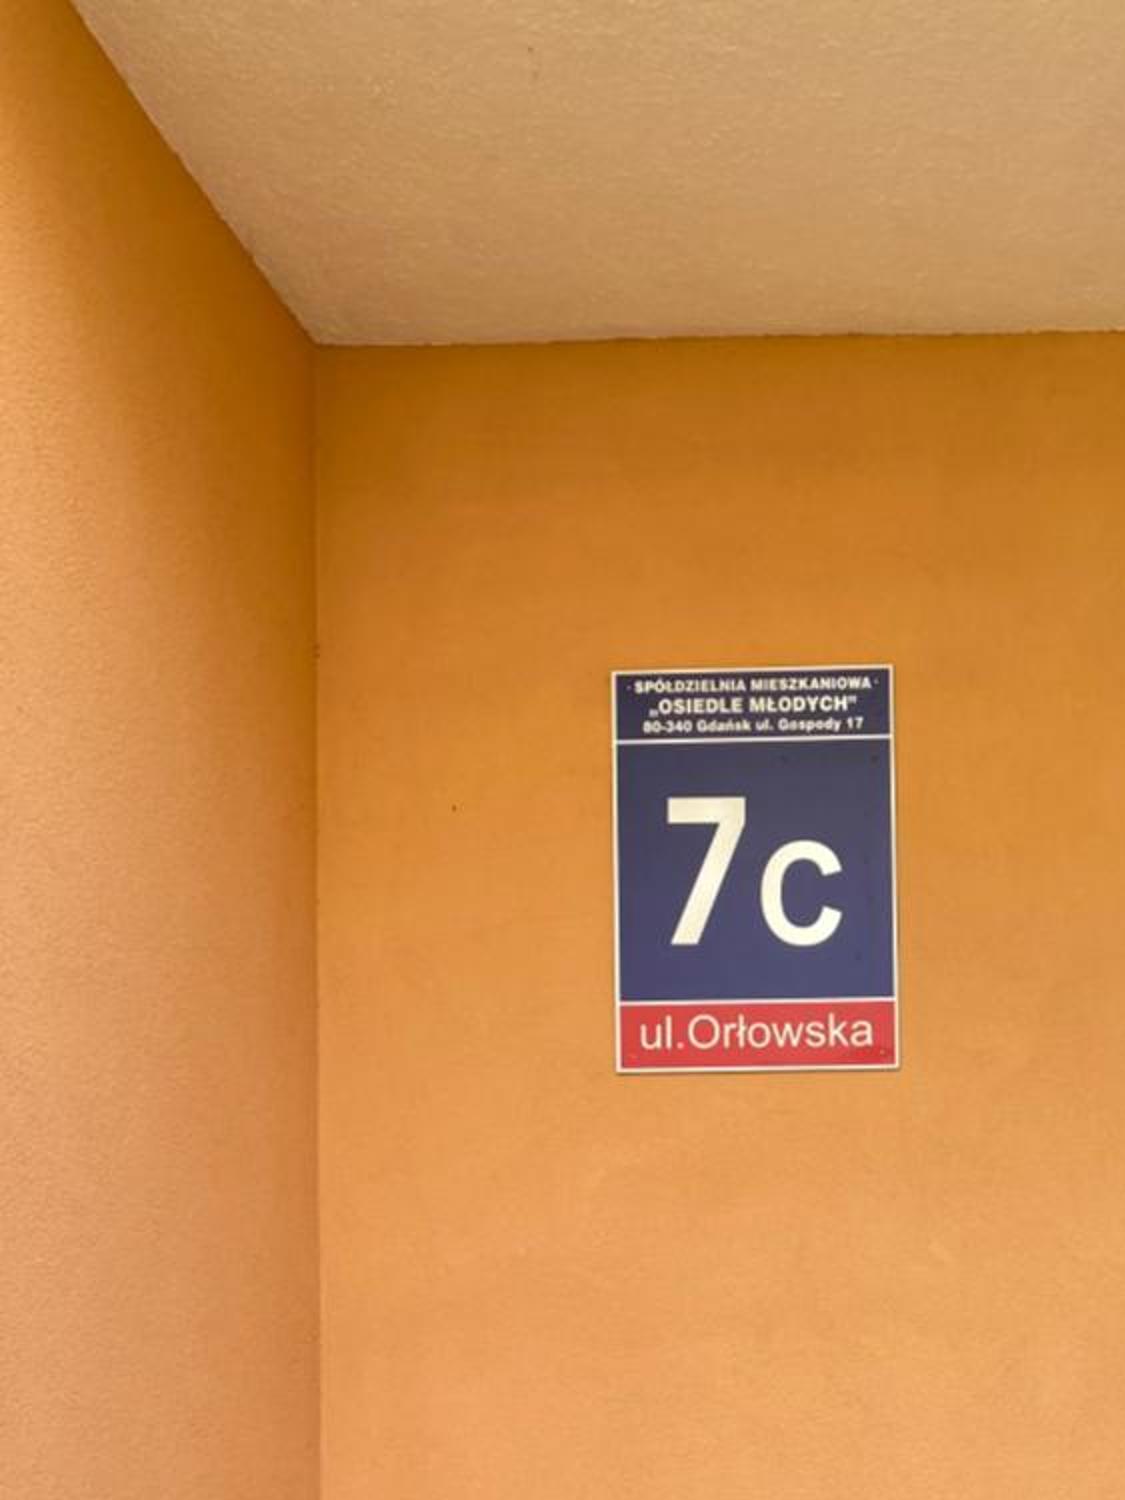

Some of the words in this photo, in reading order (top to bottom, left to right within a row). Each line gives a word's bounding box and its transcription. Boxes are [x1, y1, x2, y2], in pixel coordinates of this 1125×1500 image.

[633, 677, 747, 694] SPÓŁDZIELNIA
[750, 675, 872, 692] MIESZKANIOWA
[642, 719, 693, 734] 80-340
[696, 718, 751, 732] Gdańsk
[755, 717, 774, 731] ul.
[777, 717, 841, 732] Gospody
[846, 716, 864, 730] 17
